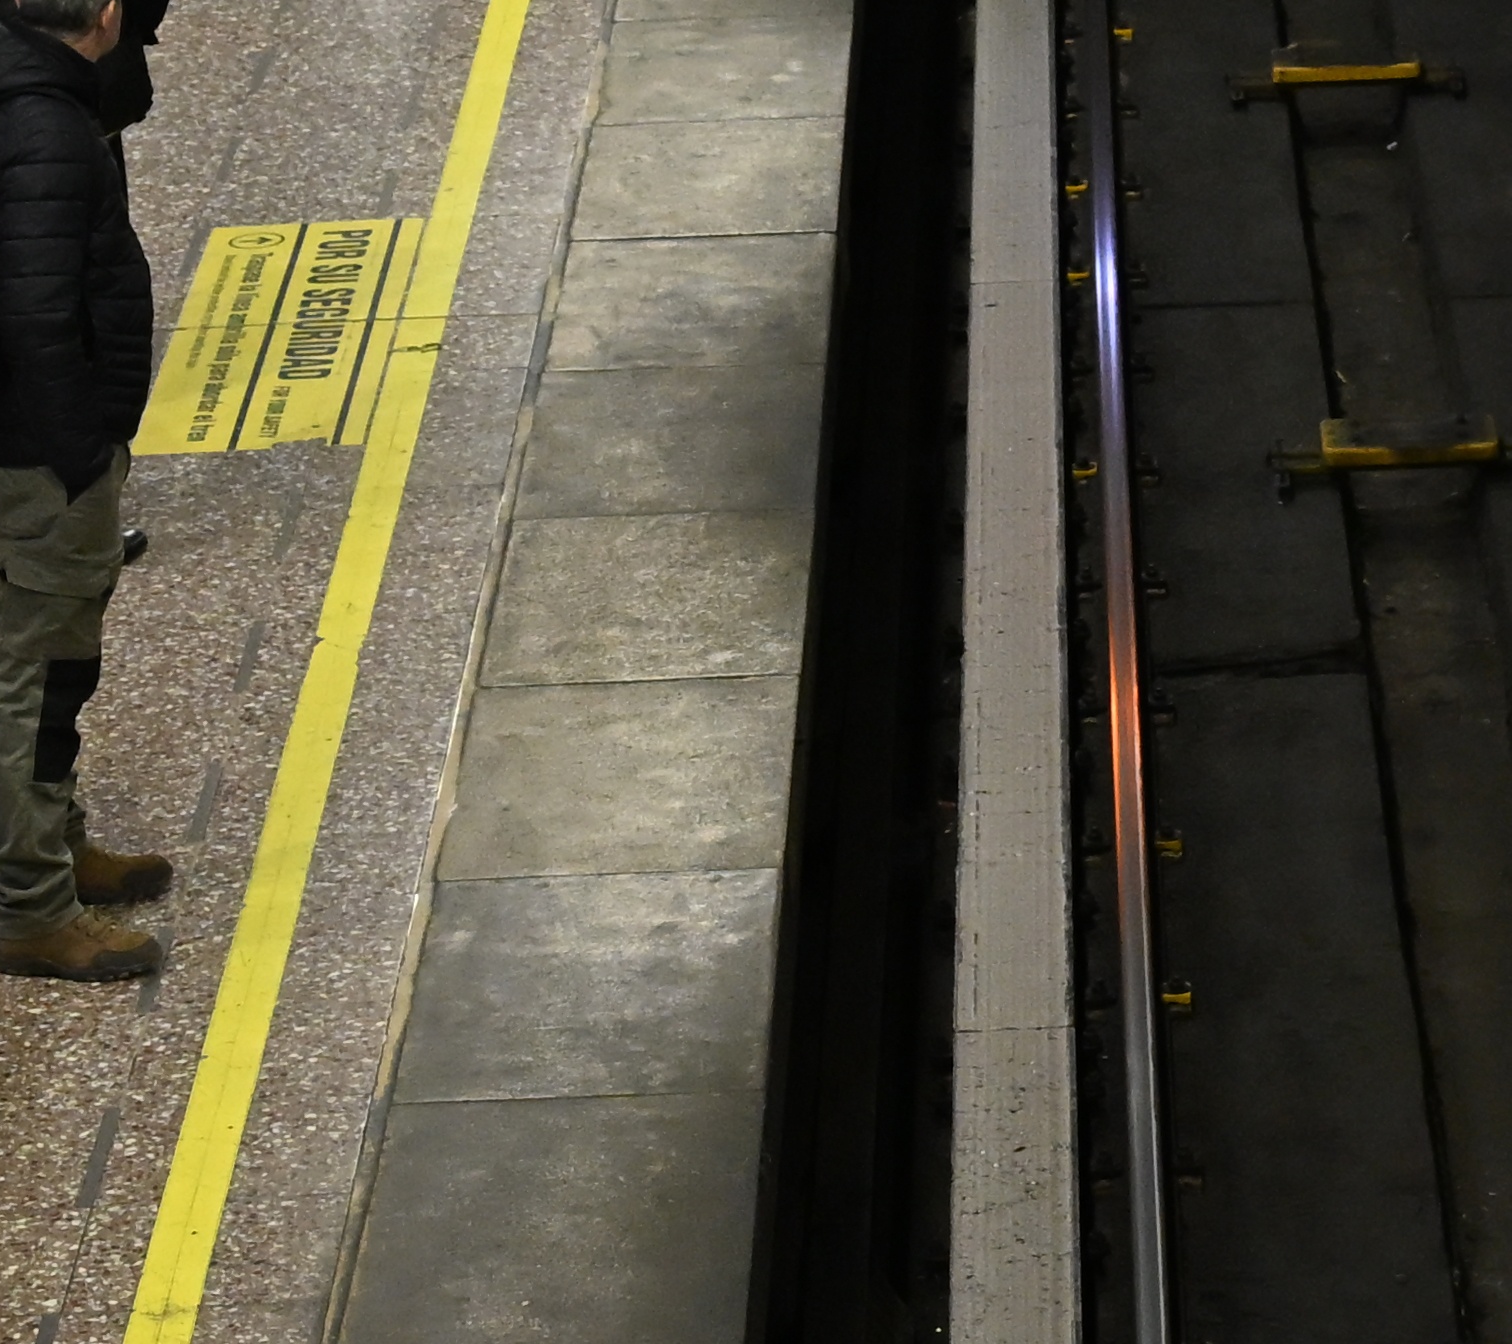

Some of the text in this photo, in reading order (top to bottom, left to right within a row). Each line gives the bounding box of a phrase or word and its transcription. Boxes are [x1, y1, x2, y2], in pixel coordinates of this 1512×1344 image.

[277, 228, 373, 381] POR SU SEGURIDAD
